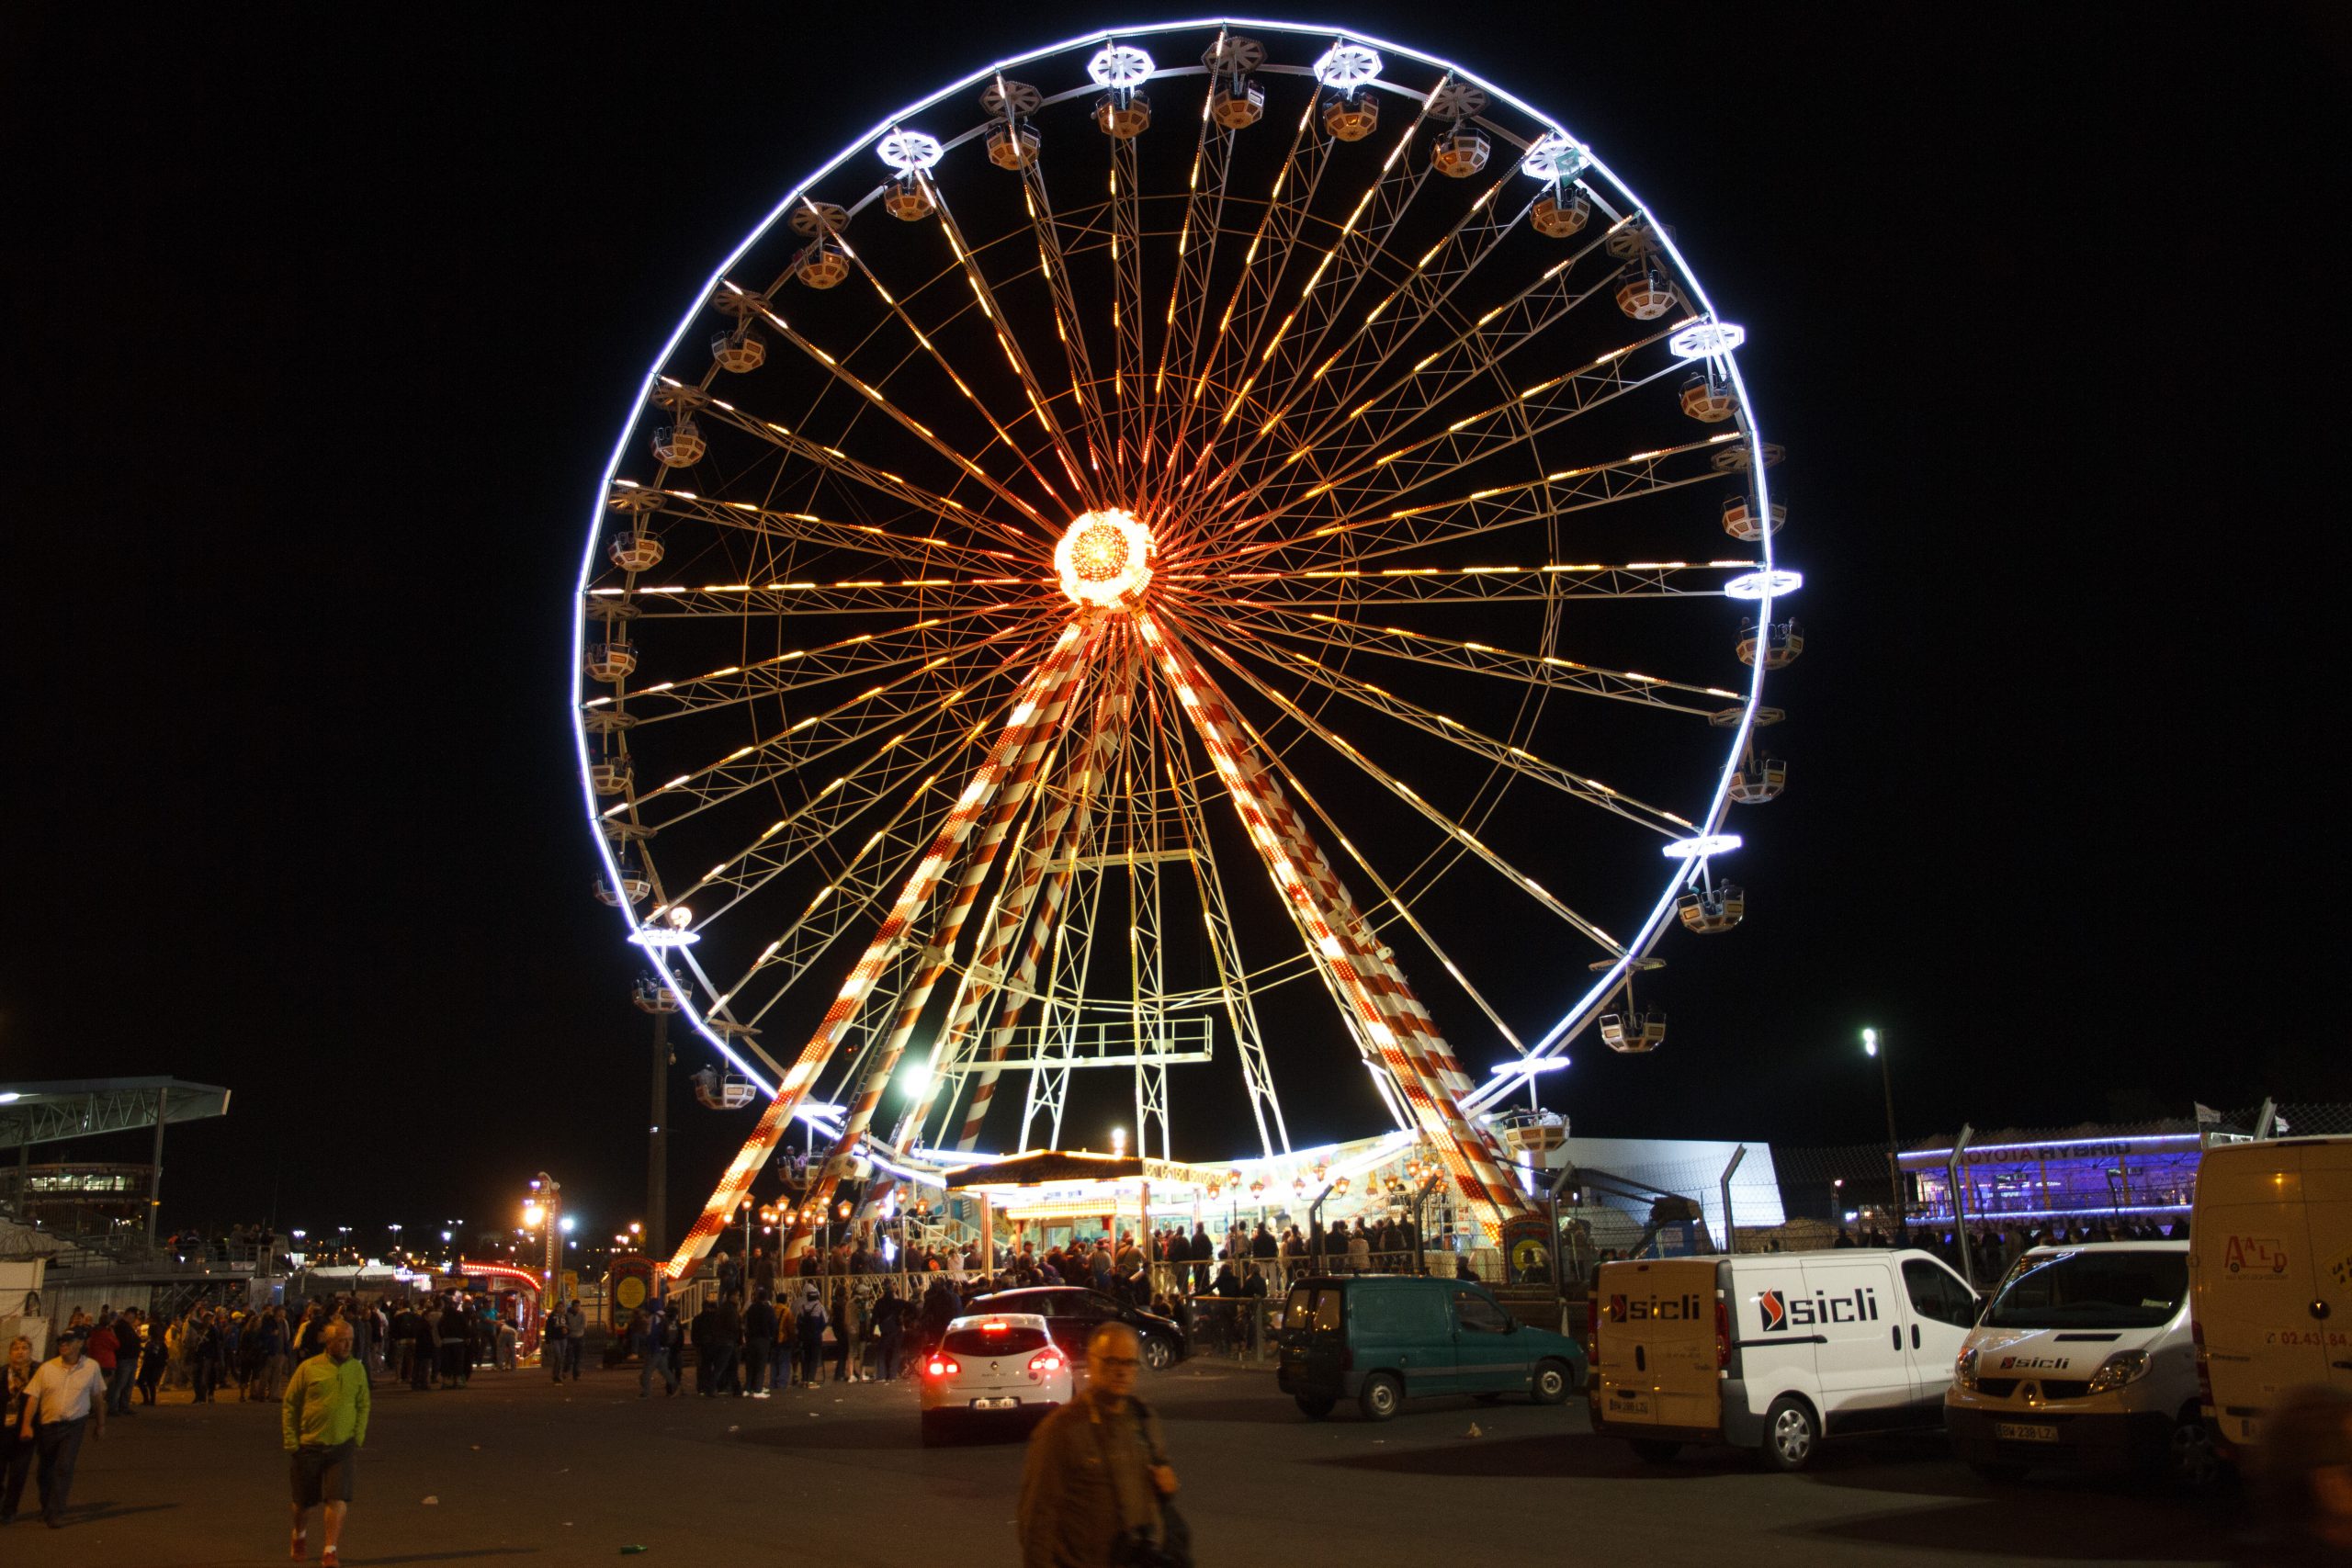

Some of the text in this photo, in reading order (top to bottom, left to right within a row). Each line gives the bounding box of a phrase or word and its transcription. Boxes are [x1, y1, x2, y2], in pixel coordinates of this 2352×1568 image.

[2038, 1142, 2132, 1160] HYBRID
[1630, 1294, 1700, 1320] sicli
[1790, 1287, 1880, 1325] sicli
[2016, 1357, 2071, 1370] sicli
[2017, 1426, 2037, 1438] 238
